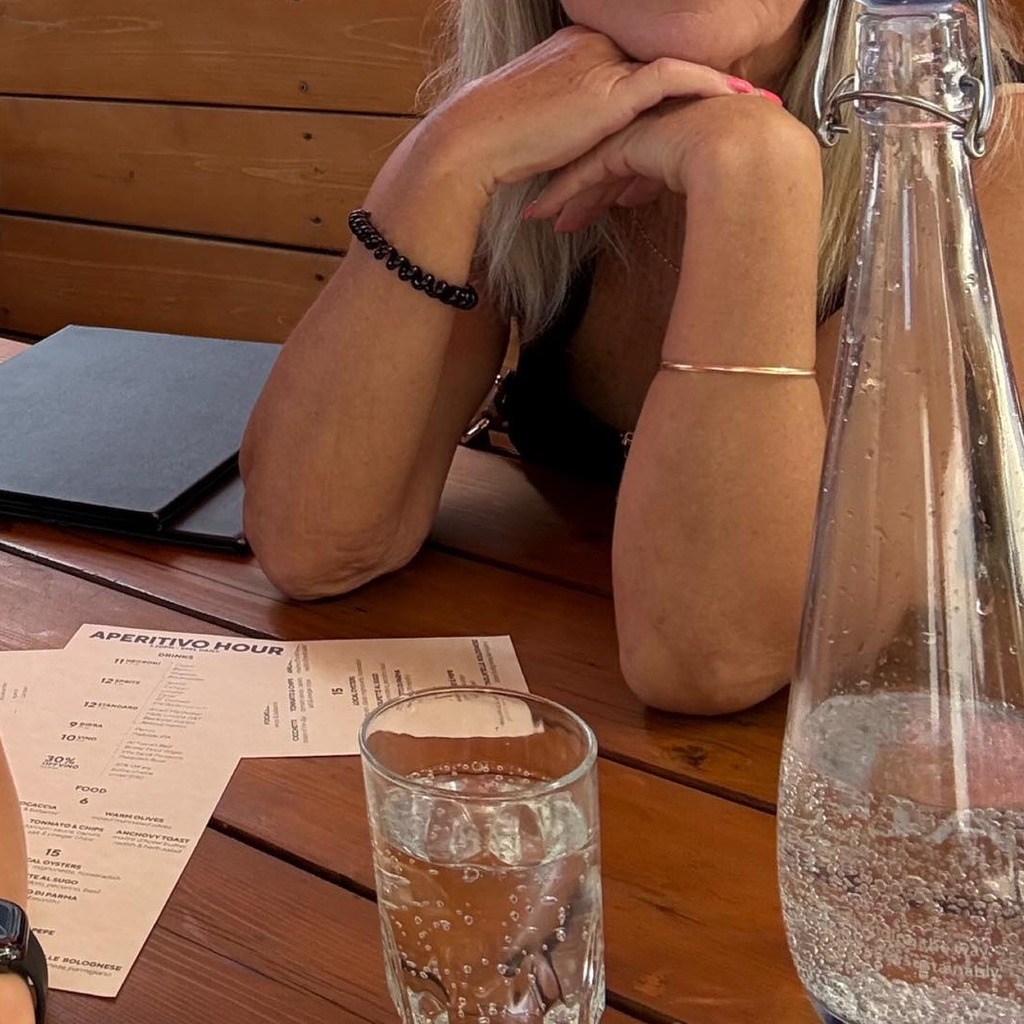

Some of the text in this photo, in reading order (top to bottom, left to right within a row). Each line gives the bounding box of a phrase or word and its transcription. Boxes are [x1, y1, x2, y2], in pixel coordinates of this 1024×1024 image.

[89, 630, 210, 650] APERITIVO
[214, 643, 285, 656] HOUR
[158, 652, 194, 660] DRINKS
[44, 755, 76, 765] 30%
[75, 785, 107, 794] FOOD
[19, 800, 57, 810] OCACCIA
[105, 811, 164, 823] WARM OLIVES
[29, 818, 71, 829] TONNATO
[78, 824, 104, 832] CHIPS
[116, 829, 191, 844] ANCHOVY TOAST
[45, 848, 62, 857] 15
[27, 857, 82, 870] CAL OYSTERS
[52, 876, 79, 885] SUGO
[34, 889, 44, 897] DI
[45, 891, 78, 901] PARMA
[31, 927, 56, 936] PEPE
[62, 957, 123, 972] BOLOGNESE
